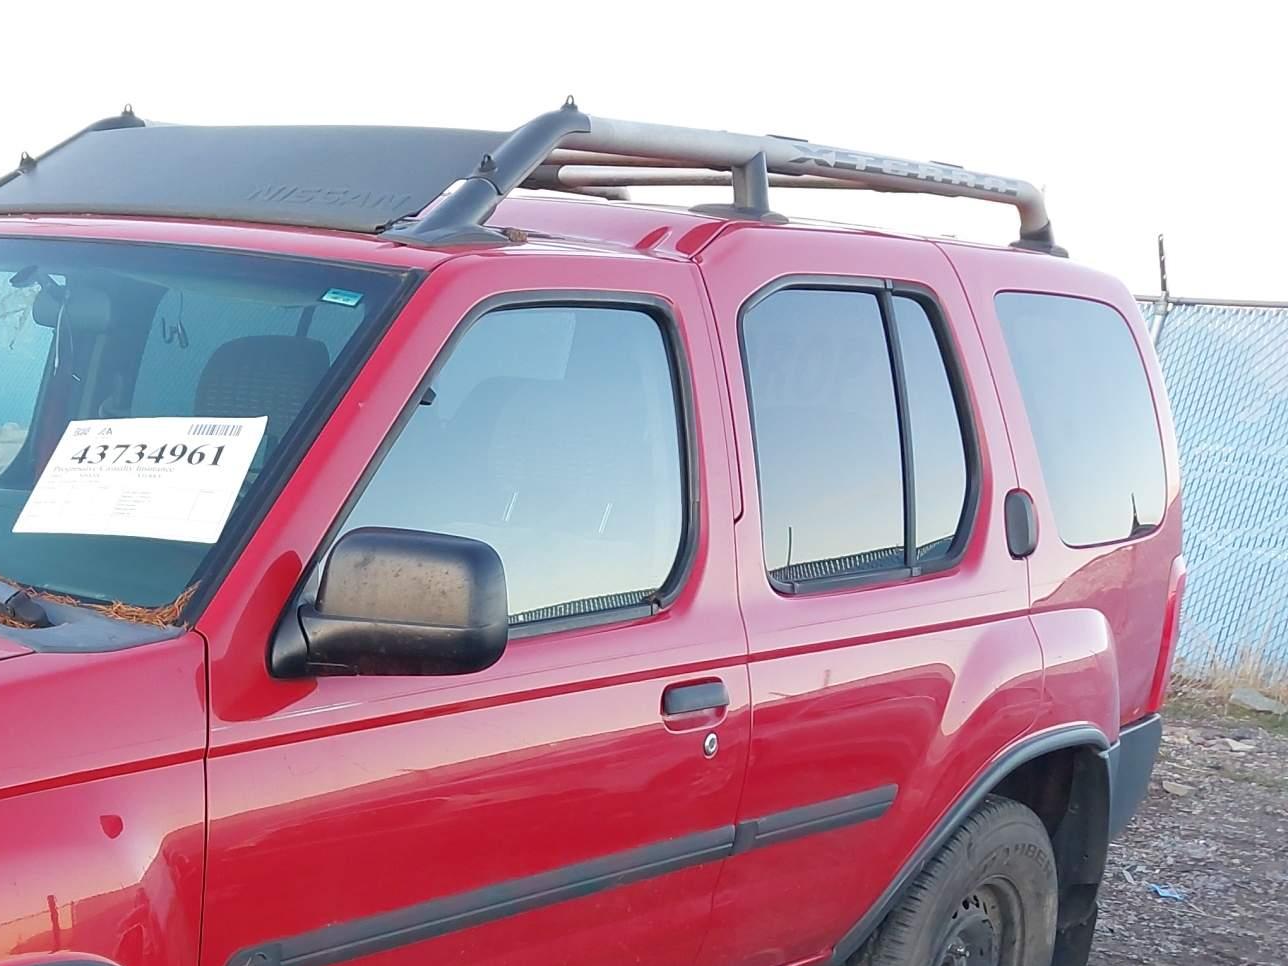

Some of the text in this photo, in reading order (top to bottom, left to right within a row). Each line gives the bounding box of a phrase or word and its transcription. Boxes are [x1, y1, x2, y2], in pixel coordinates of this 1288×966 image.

[789, 144, 1019, 197] XTERRA
[247, 183, 412, 210] NISSAN
[70, 442, 226, 466] 43734961
